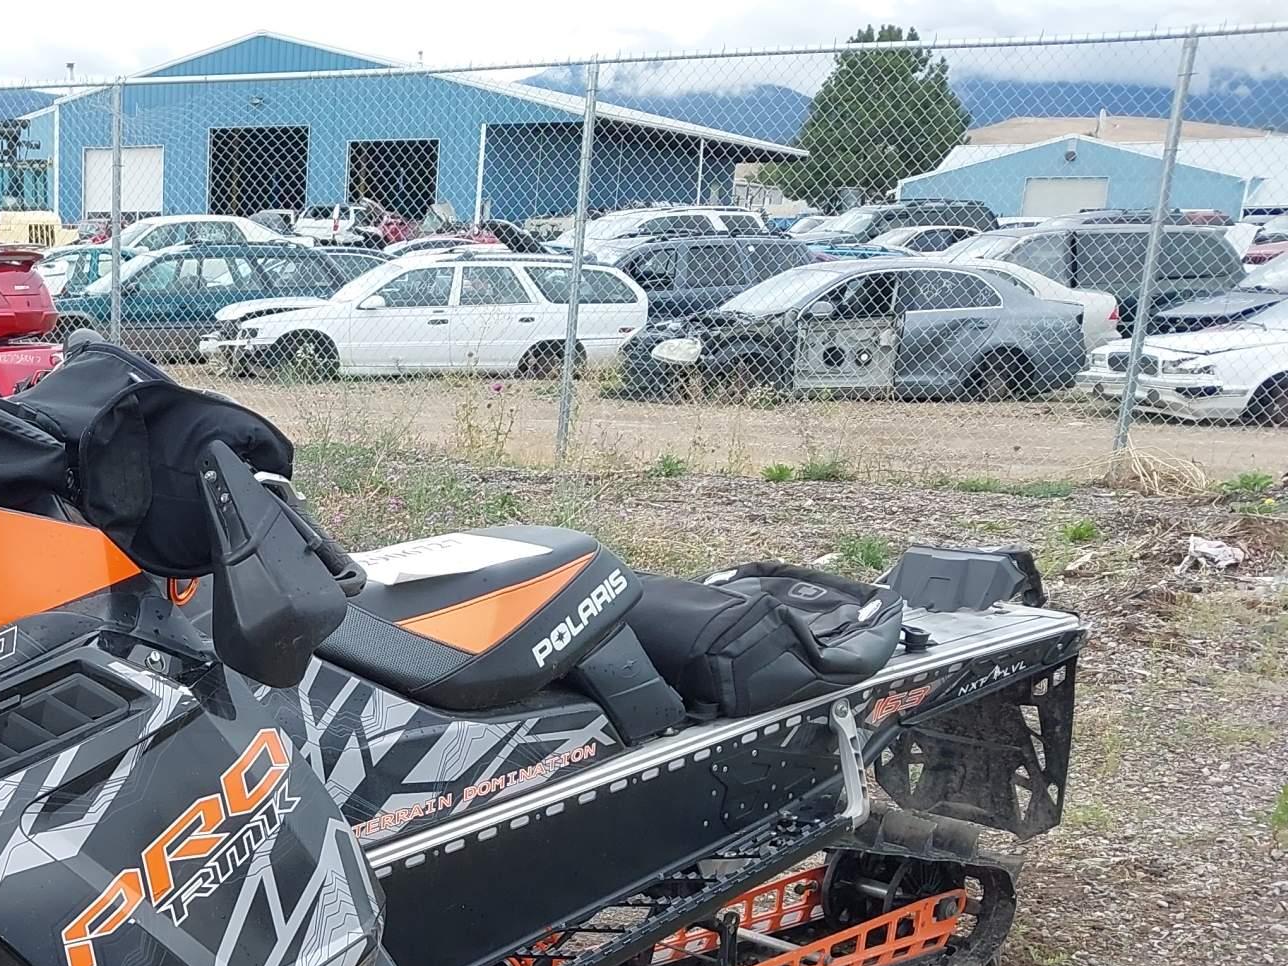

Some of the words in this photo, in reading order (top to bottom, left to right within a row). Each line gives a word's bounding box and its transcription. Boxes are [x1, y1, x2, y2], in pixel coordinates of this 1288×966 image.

[532, 568, 628, 668] POLARIS
[871, 685, 932, 724] 163
[352, 793, 453, 839] TERRAIN
[462, 743, 597, 803] DOMINATION
[156, 780, 302, 927] RMK
